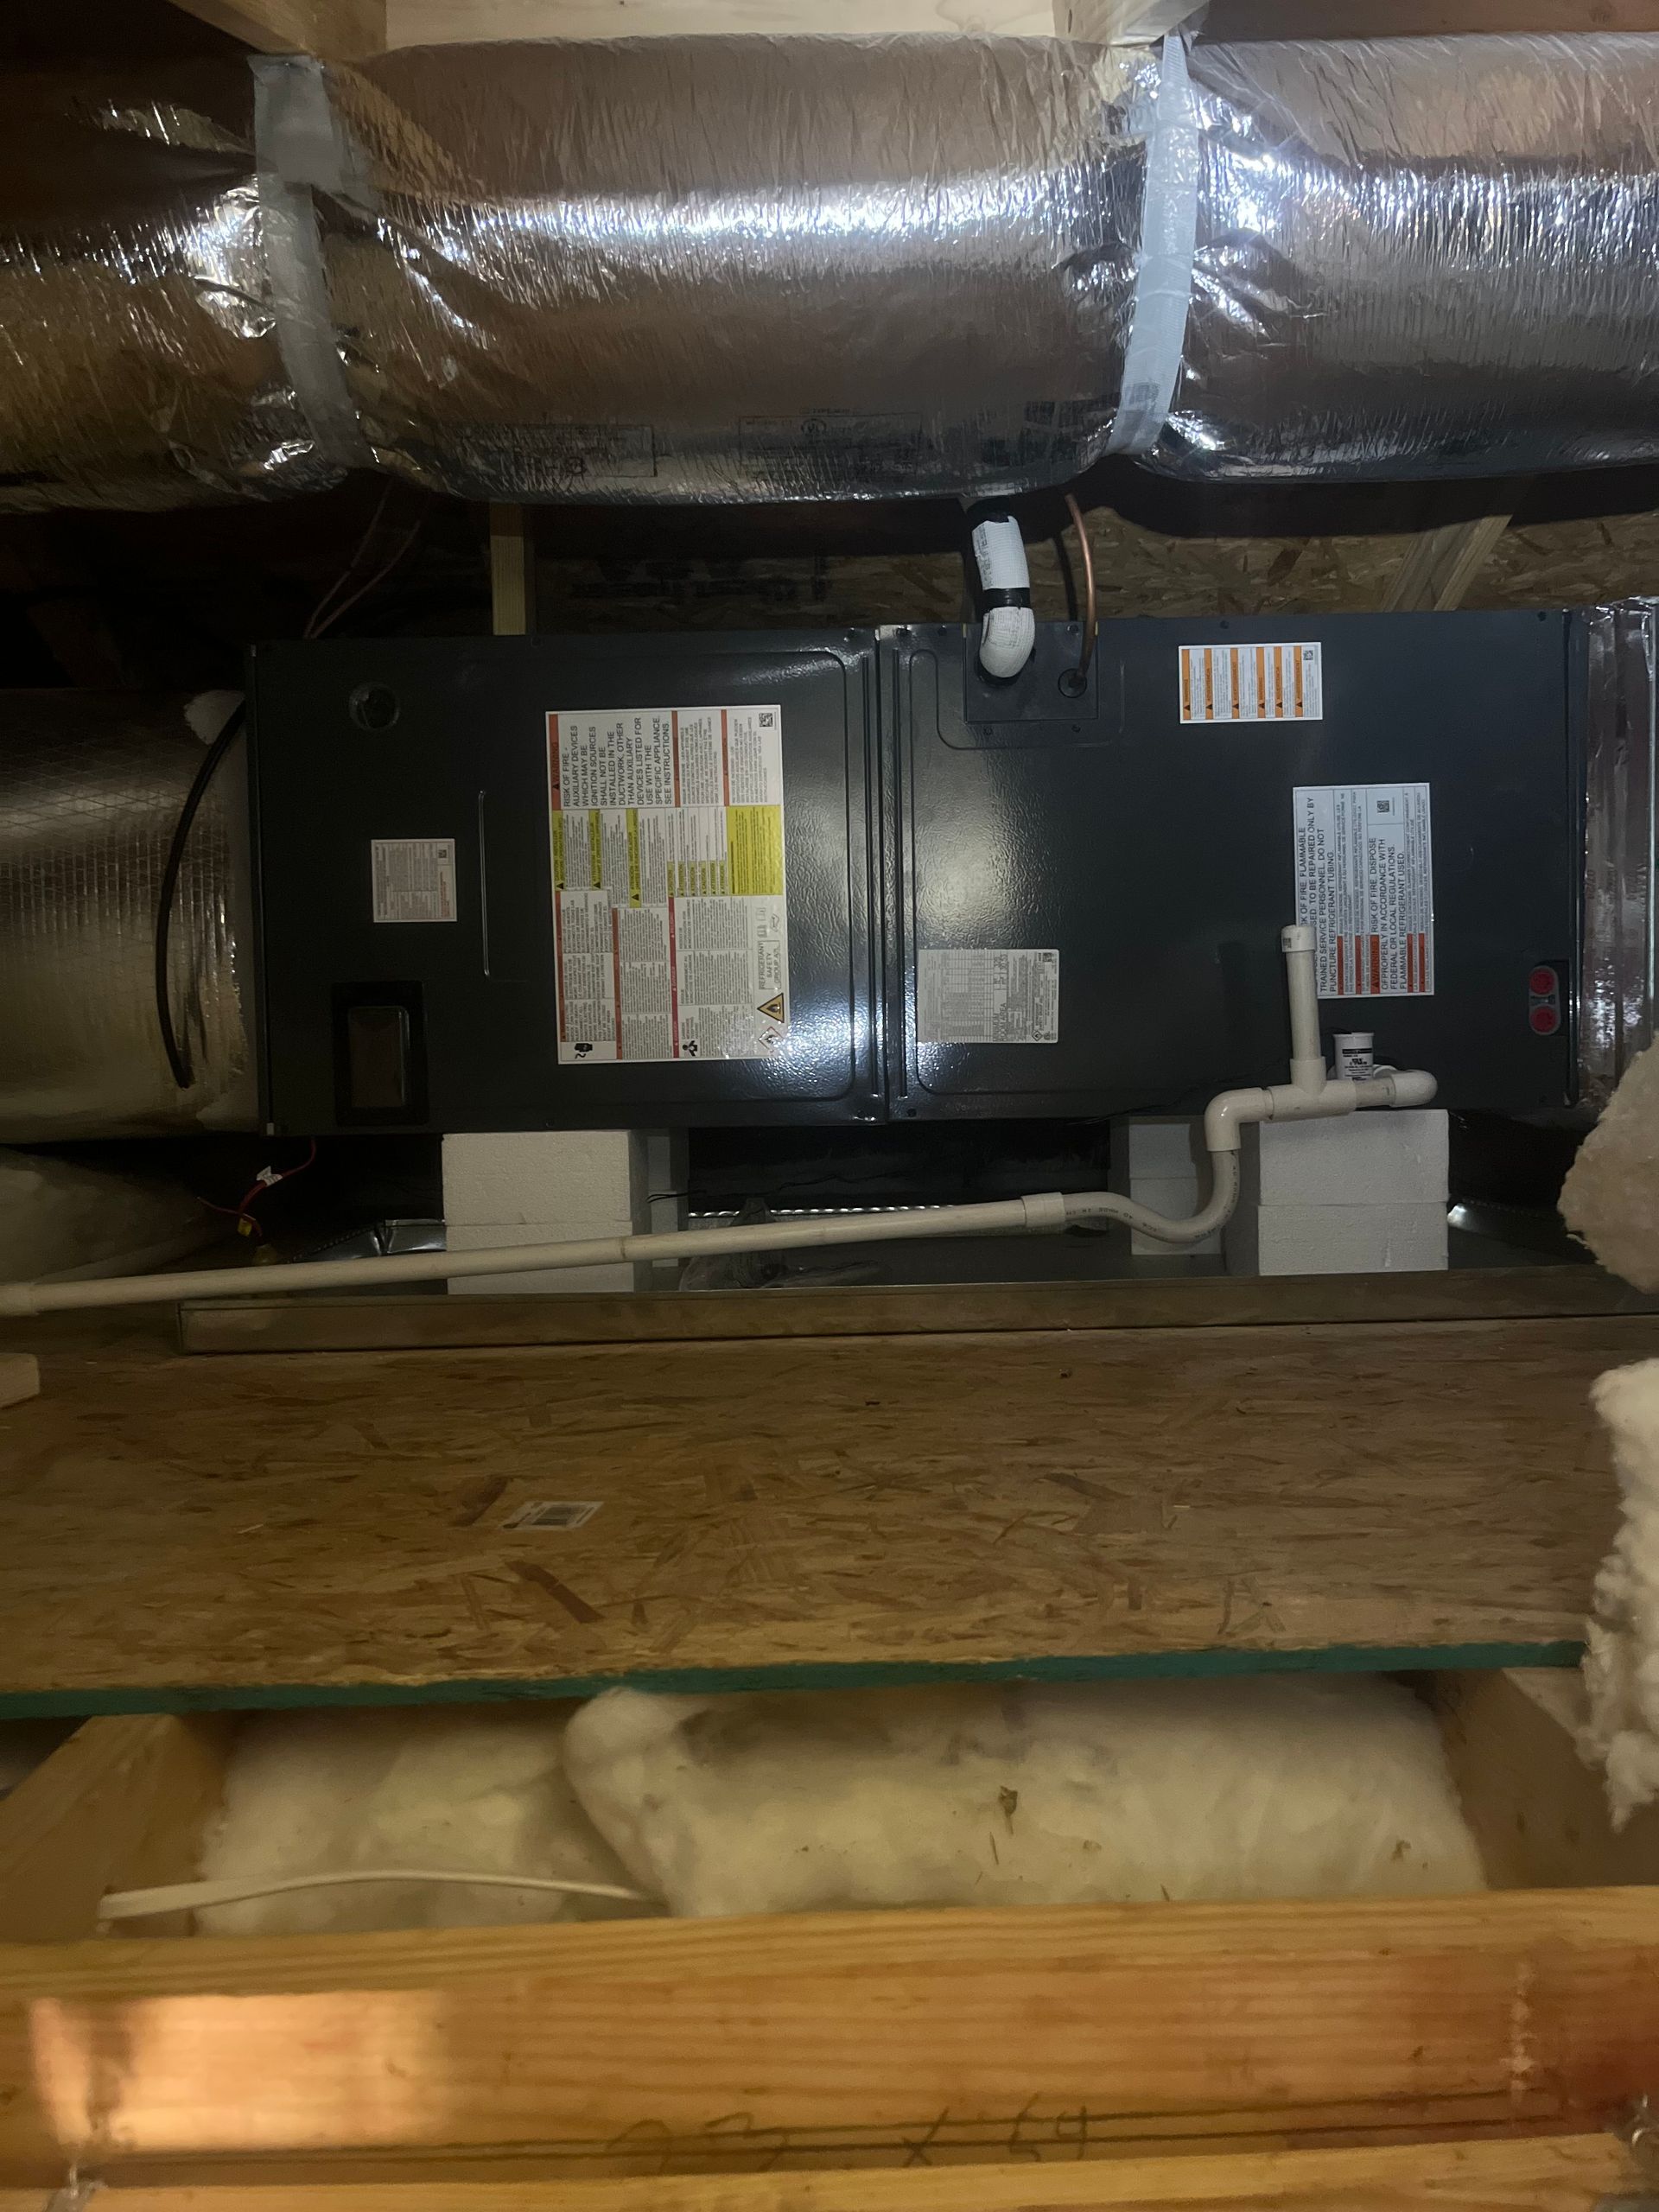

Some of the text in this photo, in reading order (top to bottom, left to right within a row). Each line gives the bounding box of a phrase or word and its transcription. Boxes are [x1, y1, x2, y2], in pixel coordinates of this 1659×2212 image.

[581, 746, 588, 756] BE
[599, 747, 605, 758] BE
[563, 774, 569, 785] OF
[1307, 798, 1314, 808] BY
[1307, 835, 1316, 877] REPAIRED
[1317, 848, 1325, 860] DO
[1309, 880, 1316, 891] BE
[1379, 863, 1388, 921] ACCORDANCE
[1309, 893, 1317, 904] TO
[1300, 903, 1308, 913] OF
[1370, 899, 1377, 911] OF
[1388, 844, 1398, 989] FEDERAL OR LOCAL REGULATIONS.
[1380, 935, 1389, 989] OFPROPERLY
